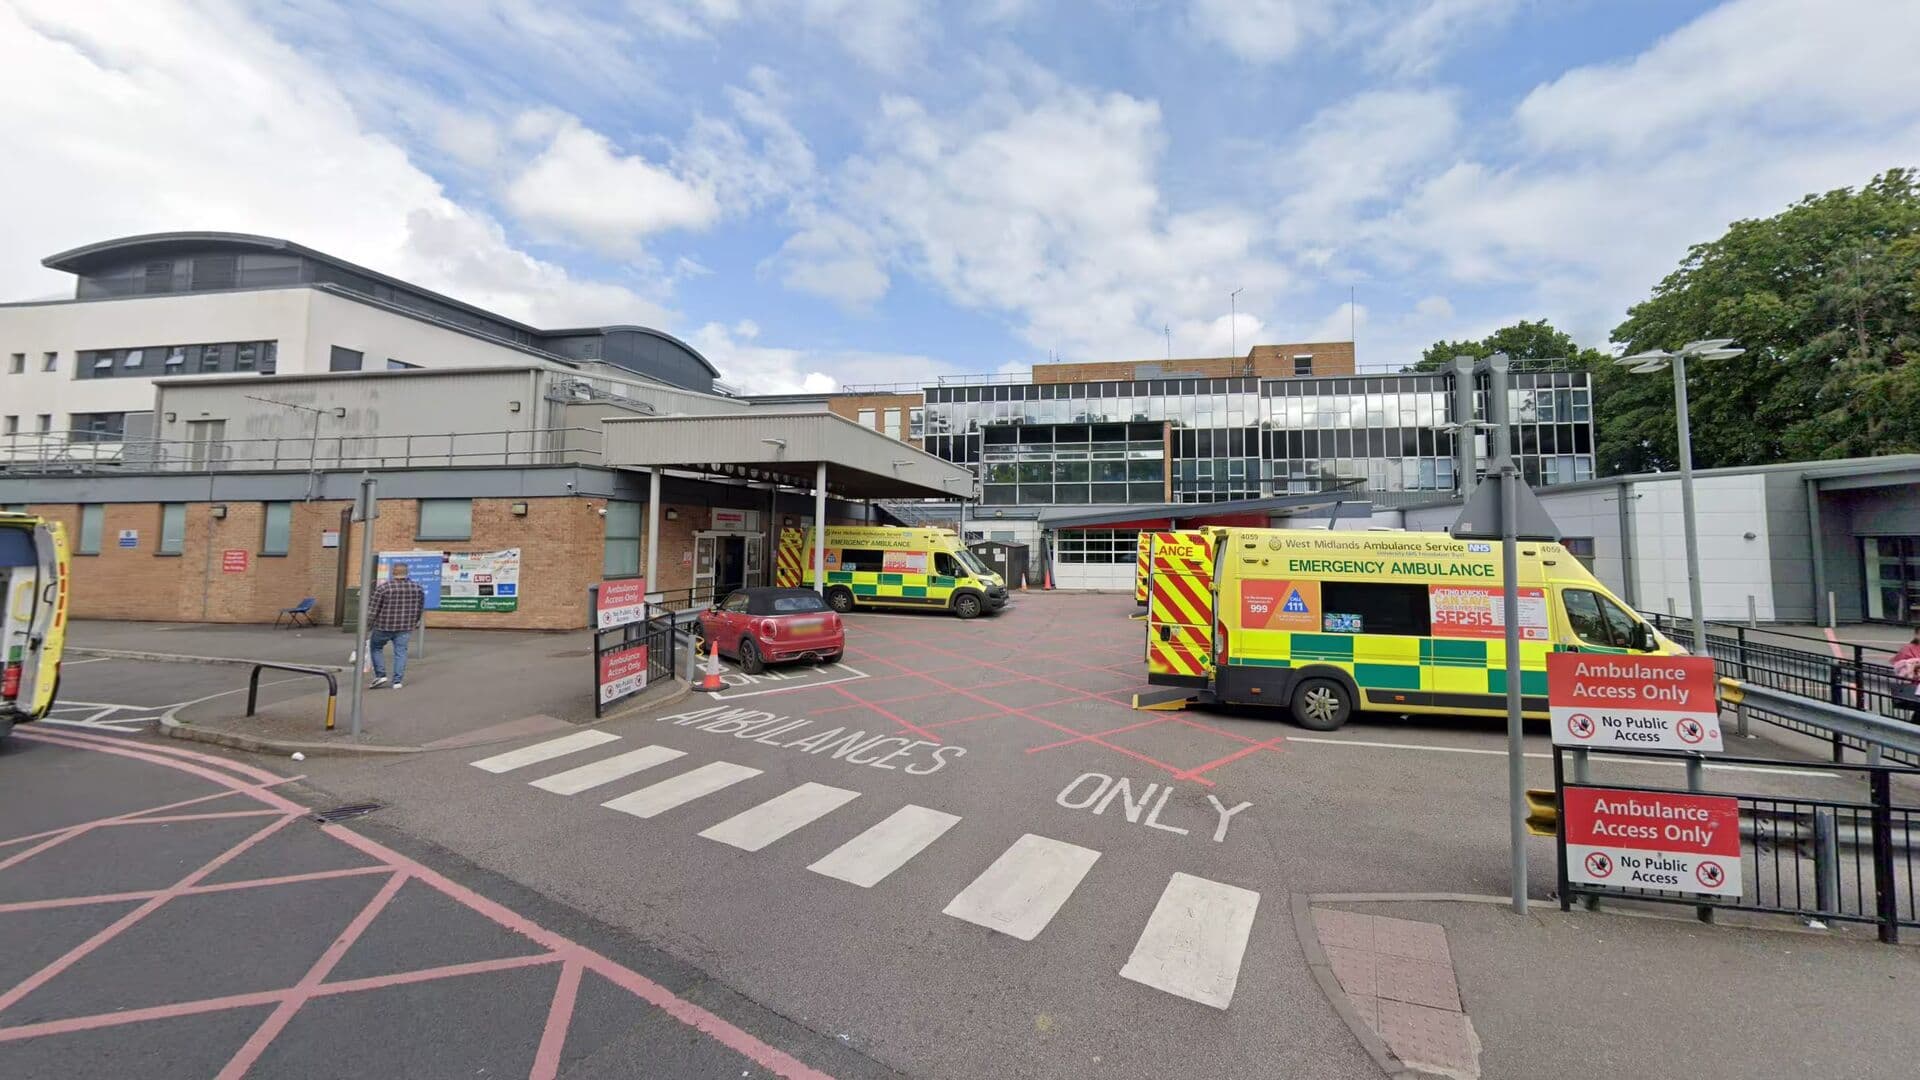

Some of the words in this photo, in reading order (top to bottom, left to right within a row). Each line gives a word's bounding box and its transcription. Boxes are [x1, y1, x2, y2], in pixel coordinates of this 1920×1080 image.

[1286, 539, 1310, 548] West
[1314, 540, 1360, 550] Midlands
[1363, 541, 1422, 551] Ambulance
[1425, 542, 1464, 552] Service
[1469, 544, 1490, 553] NHS
[1289, 559, 1384, 574] EMERGENCY
[1391, 561, 1495, 577] AMBULANCE
[607, 583, 639, 594] Ambulance
[605, 595, 624, 604] Access
[624, 593, 639, 603] Only
[1250, 604, 1268, 613] 999
[1288, 602, 1304, 611] 111
[1435, 610, 1493, 626] SEPSIS
[609, 653, 640, 665] Ambulance
[608, 667, 627, 677] Access
[627, 662, 641, 671] Only
[1574, 662, 1686, 680] Ambulance
[1572, 683, 1635, 699] Access
[1641, 685, 1689, 705] Only
[1602, 716, 1622, 728] No
[1626, 717, 1668, 730] Public
[656, 705, 967, 775] AMBULANCES
[1614, 730, 1660, 742] Access
[1056, 772, 1254, 842] ONLY
[1593, 798, 1708, 821] Ambulance
[1591, 820, 1657, 839] Access
[1664, 825, 1712, 847] Only
[1621, 856, 1640, 869] No
[1645, 857, 1687, 873] Public
[1631, 870, 1678, 885] Access
